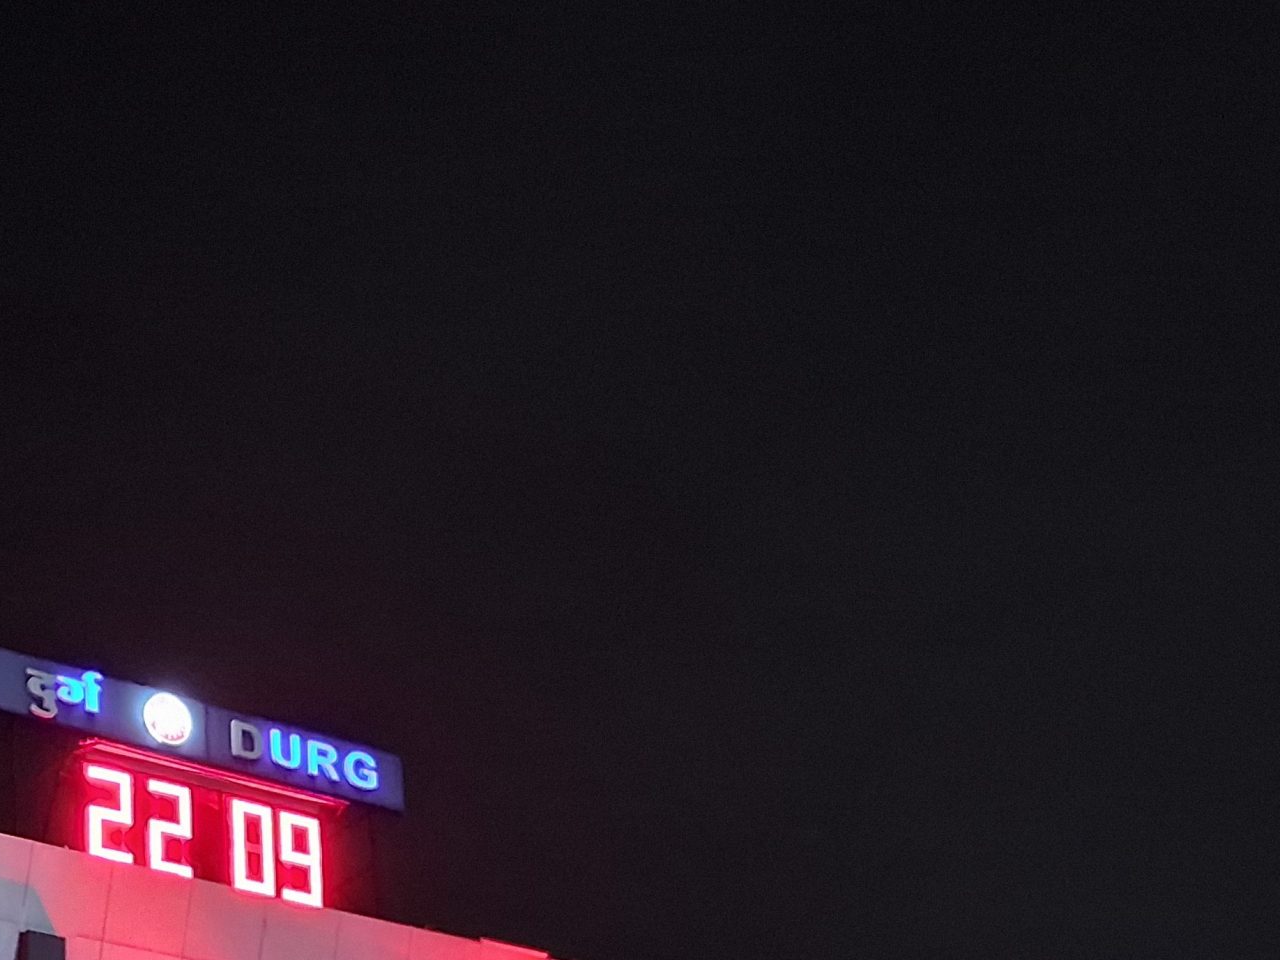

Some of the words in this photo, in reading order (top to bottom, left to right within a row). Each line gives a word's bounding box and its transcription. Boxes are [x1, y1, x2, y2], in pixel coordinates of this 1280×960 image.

[230, 718, 380, 792] DURG
[85, 764, 195, 880] 22
[229, 797, 325, 909] 09
